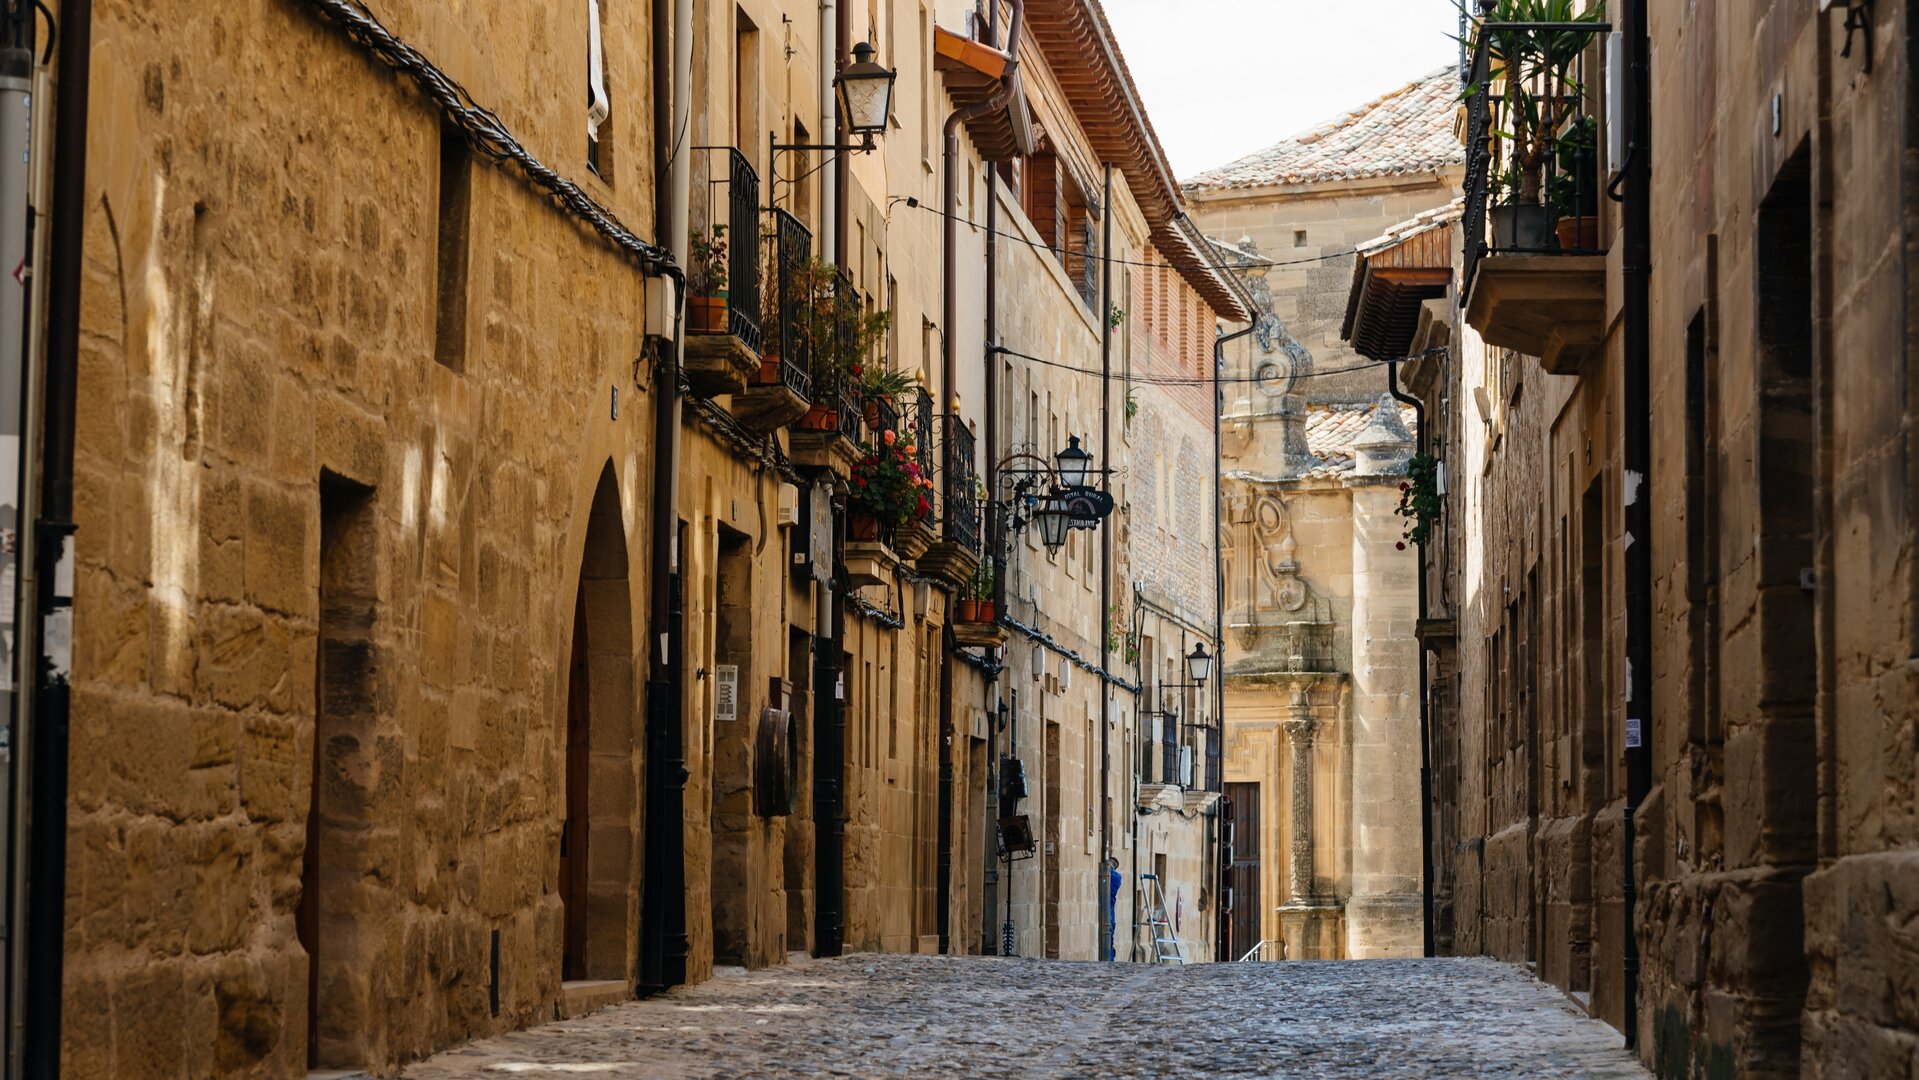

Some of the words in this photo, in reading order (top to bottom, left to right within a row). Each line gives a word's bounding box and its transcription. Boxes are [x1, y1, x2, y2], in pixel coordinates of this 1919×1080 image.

[1064, 491, 1081, 500] OSTAL
[1084, 490, 1103, 503] RURAL
[1068, 518, 1095, 527] STAURANTE
